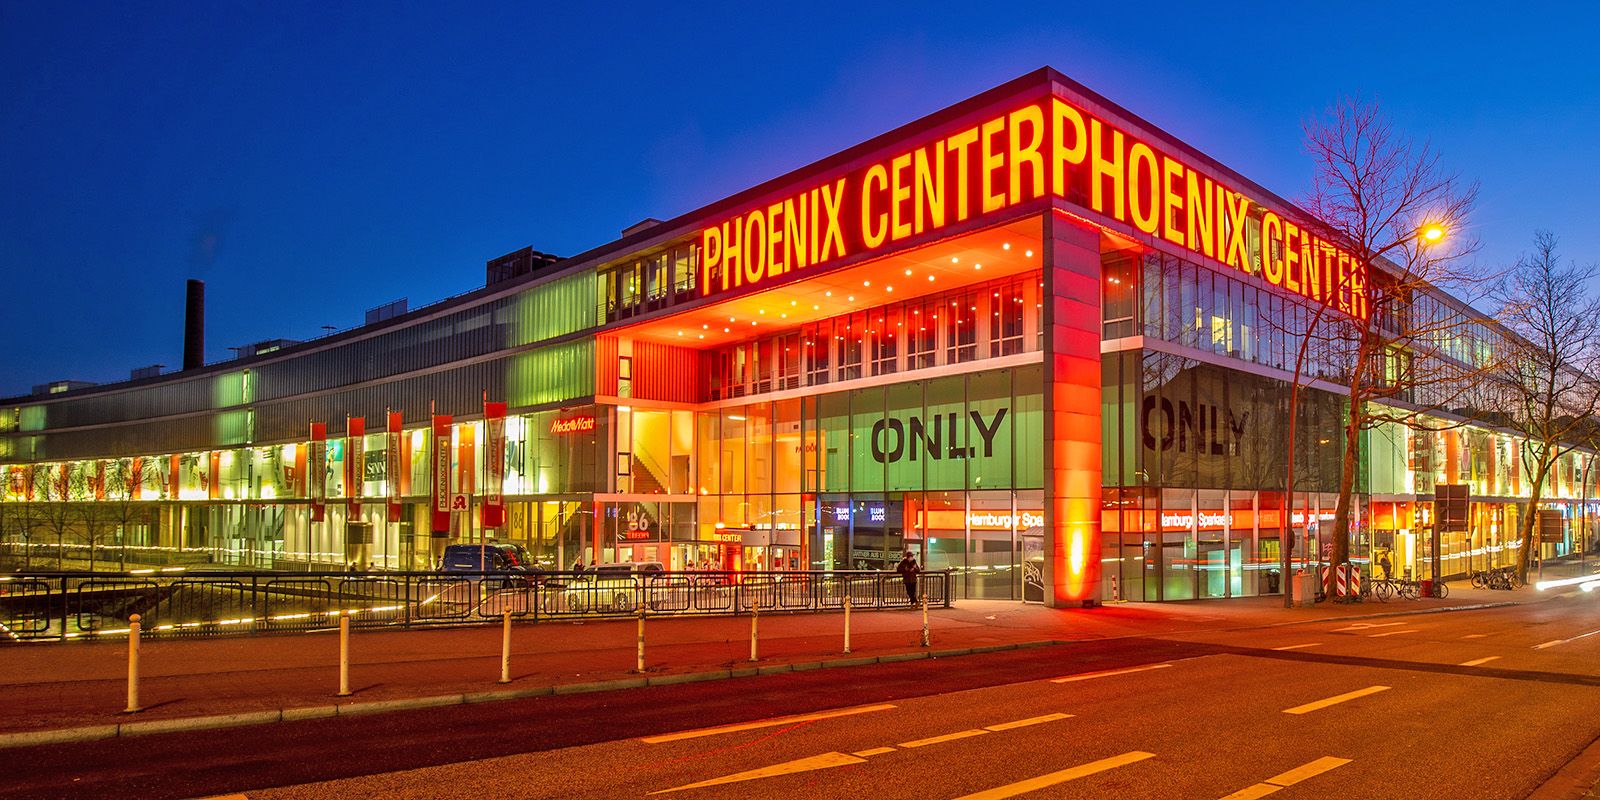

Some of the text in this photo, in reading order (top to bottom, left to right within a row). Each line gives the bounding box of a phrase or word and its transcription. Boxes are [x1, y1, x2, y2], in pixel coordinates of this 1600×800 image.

[703, 105, 1045, 296] PHOENIX CENTER
[1052, 97, 1367, 320] PHOENIX CENTER
[871, 408, 1008, 463] ONLY
[1140, 394, 1250, 457] ONLY
[513, 511, 523, 529] 86
[1198, 512, 1233, 528] Sparkase
